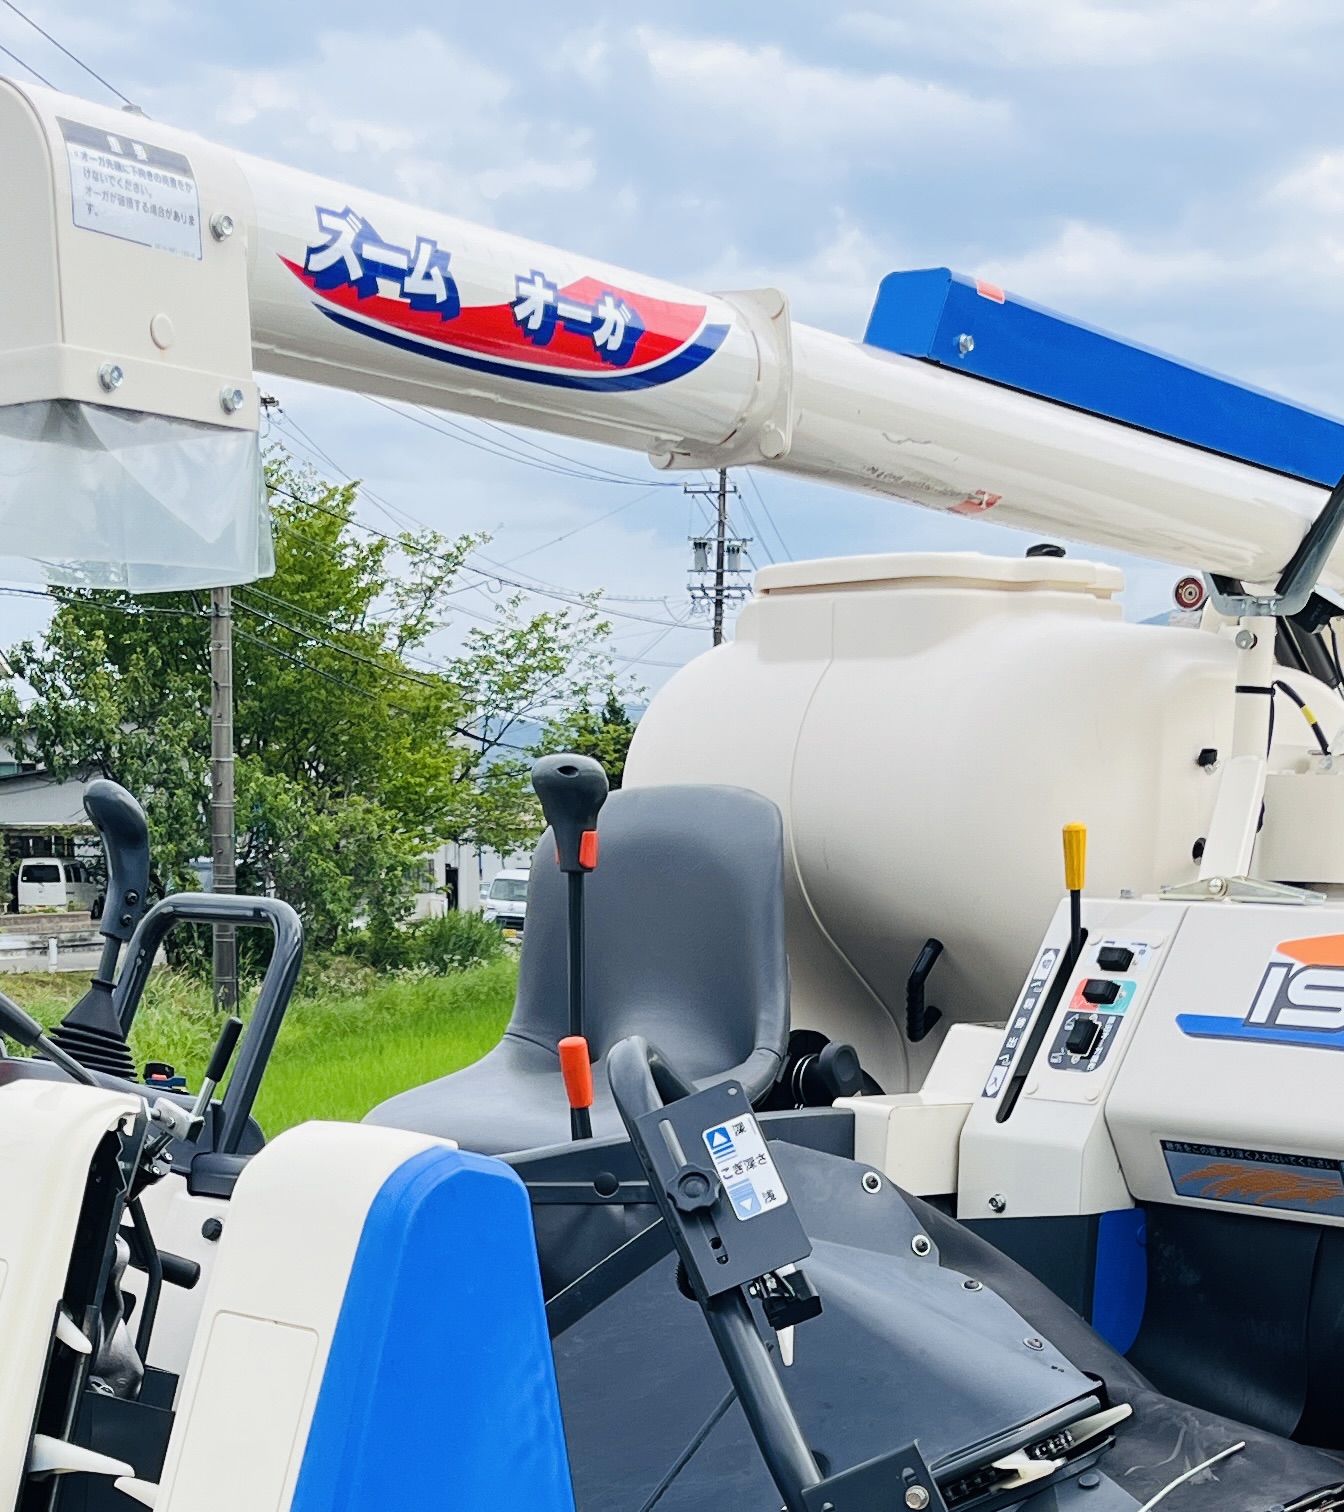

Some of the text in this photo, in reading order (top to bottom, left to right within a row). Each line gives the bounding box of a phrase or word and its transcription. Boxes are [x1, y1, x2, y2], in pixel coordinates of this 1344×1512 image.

[304, 207, 640, 359] ズーム オーガ
[721, 1153, 767, 1180] こぎ深さ
